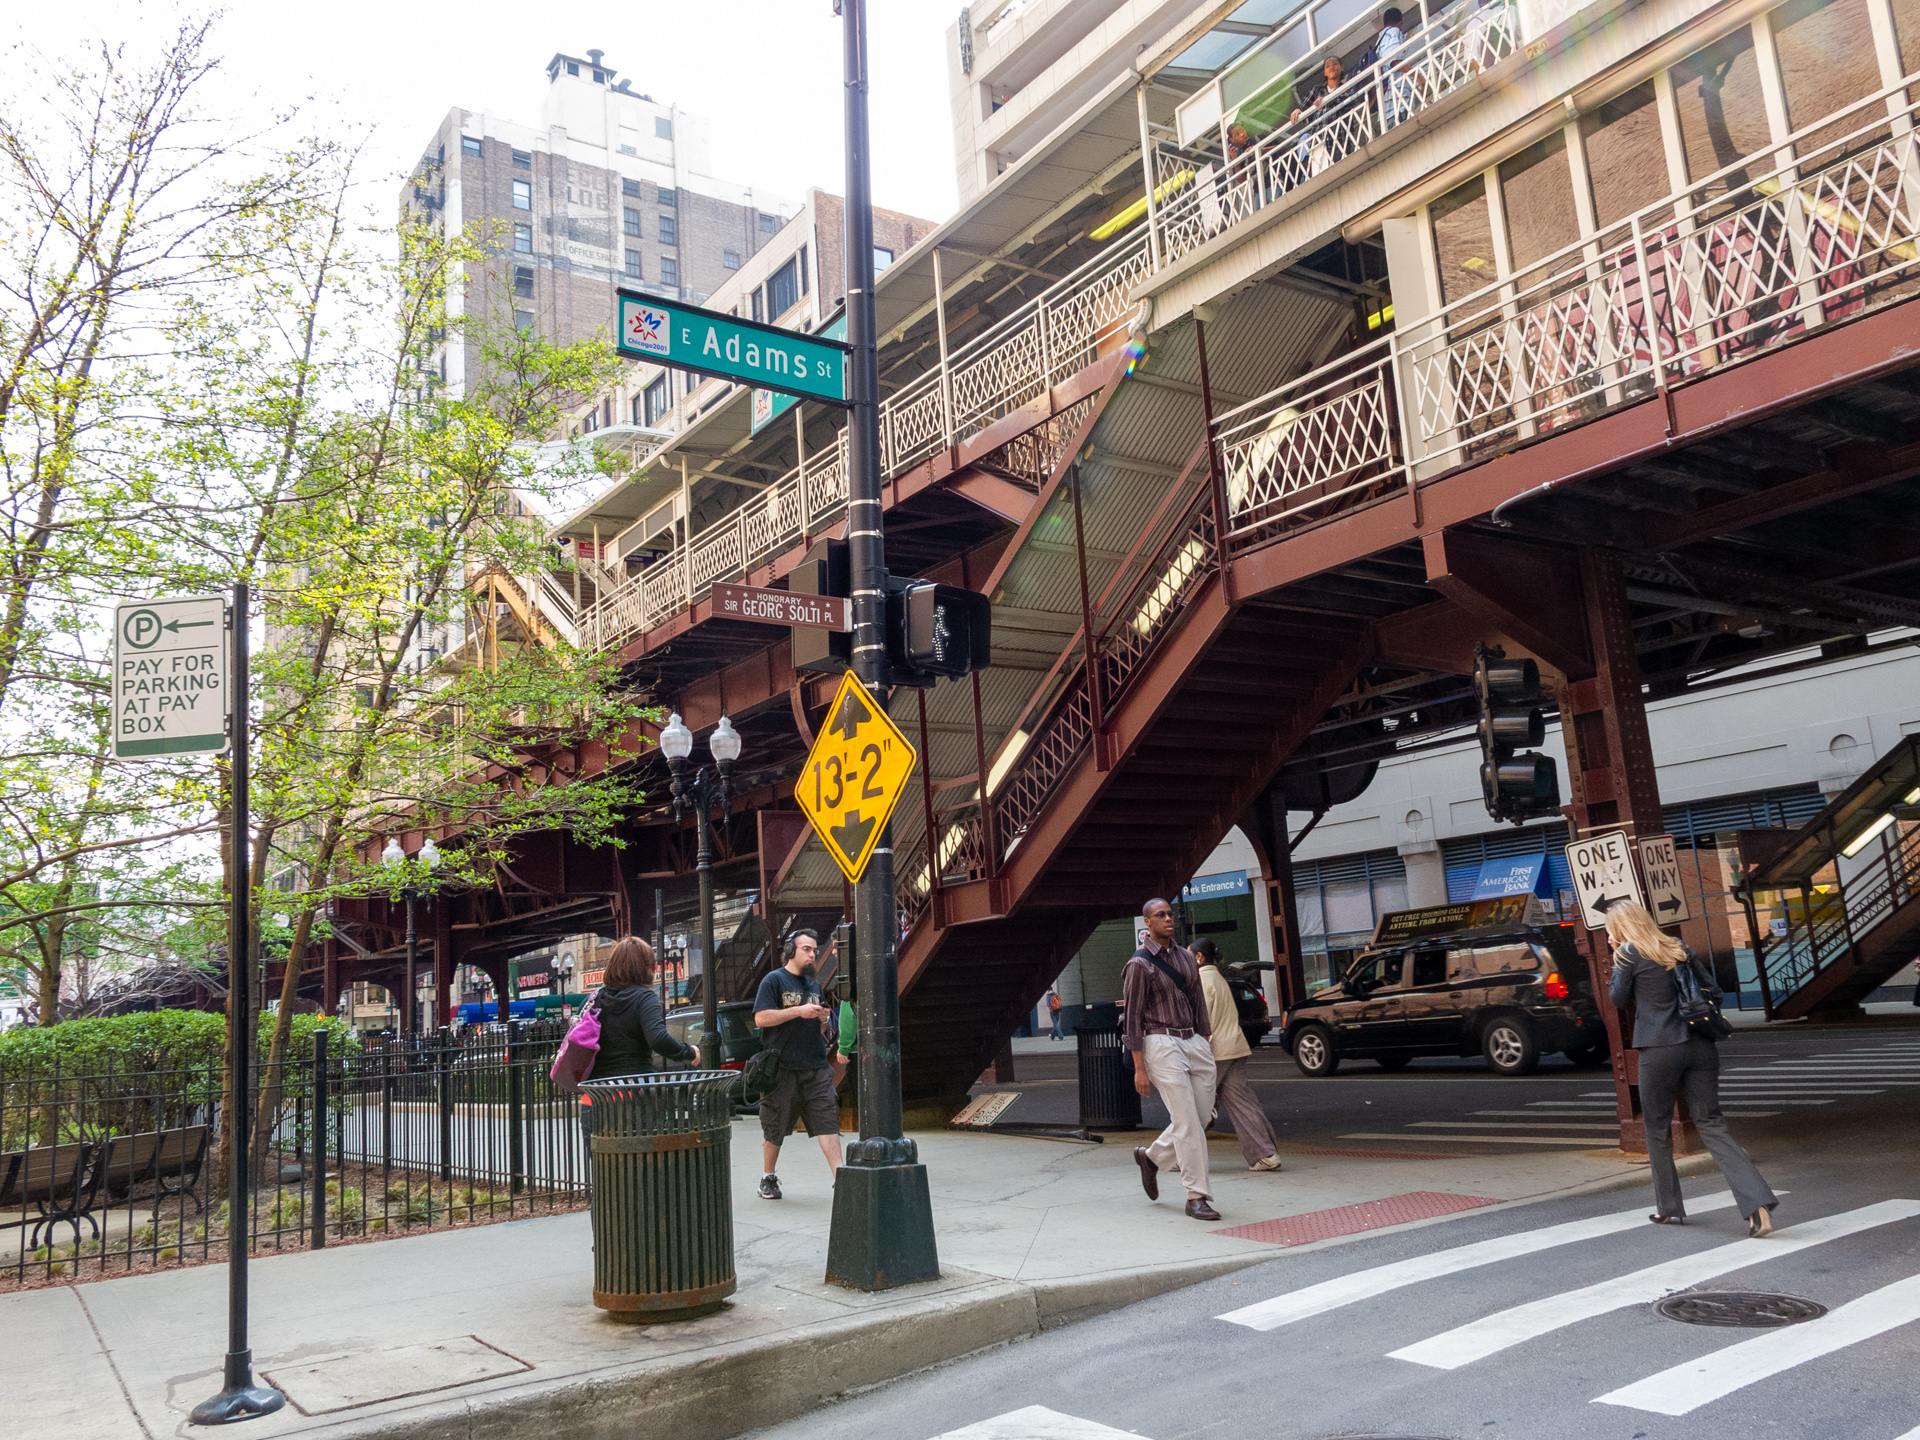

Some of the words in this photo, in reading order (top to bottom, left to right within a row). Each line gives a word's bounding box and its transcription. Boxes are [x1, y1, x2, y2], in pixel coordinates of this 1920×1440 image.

[682, 328, 691, 345] E
[702, 326, 808, 378] Adams
[816, 361, 832, 378] St
[757, 593, 801, 605] HONORARY
[724, 600, 738, 612] SIR
[742, 599, 783, 619] GEORG
[789, 605, 820, 623] SOLTI
[824, 611, 834, 623] PL
[135, 617, 153, 642] P
[122, 658, 164, 677] PAY
[172, 654, 214, 672] FOR
[122, 672, 219, 696] PARKING
[123, 698, 150, 715] AT
[158, 694, 200, 712] PAY
[122, 716, 166, 735] BOX
[813, 738, 891, 813] 13'-2"
[1577, 841, 1620, 867] ONE
[1645, 843, 1673, 866] ONE
[1481, 874, 1530, 887] AMERICAN
[1510, 866, 1534, 876] FIRST
[1648, 867, 1677, 890] WAY
[1183, 886, 1200, 896] Prk
[1201, 881, 1235, 893] Entrance
[1503, 881, 1530, 893] BANK
[1391, 915, 1405, 923] GET
[1405, 912, 1421, 921] FREE
[1421, 908, 1448, 919] incoming
[1418, 918, 1437, 928] FROM
